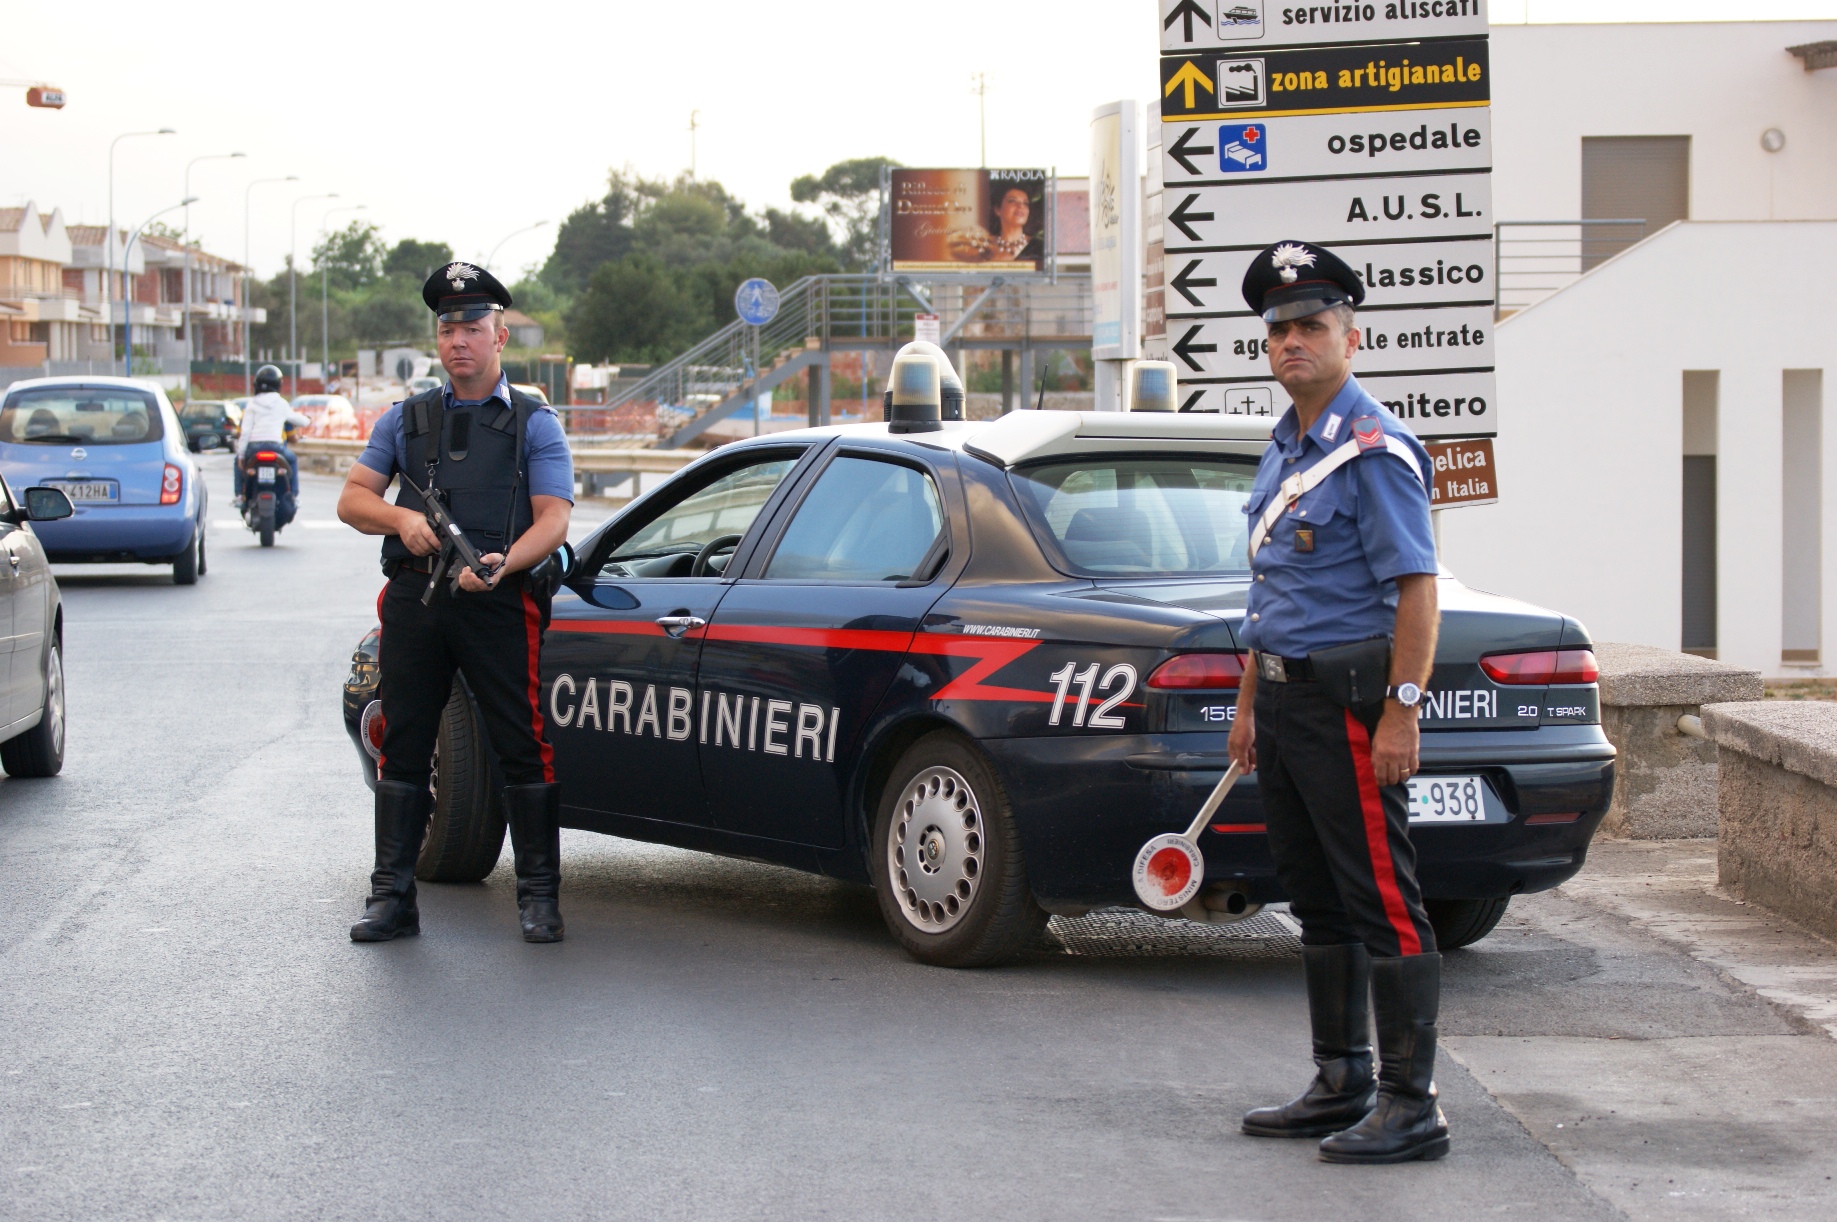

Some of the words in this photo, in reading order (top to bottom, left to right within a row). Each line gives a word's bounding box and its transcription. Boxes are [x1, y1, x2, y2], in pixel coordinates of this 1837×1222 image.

[1282, 0, 1375, 25] servizio
[1271, 70, 1329, 92] zona
[1338, 56, 1482, 92] artigianale
[1327, 123, 1482, 157] ospedale
[1001, 169, 1045, 182] RAJOLA
[1346, 192, 1482, 223] A.U.S.L.
[1397, 323, 1485, 348] entrate
[1447, 478, 1489, 498] Italia
[1048, 661, 1138, 729] 112
[550, 673, 841, 763] CARABINIERI
[1138, 845, 1157, 875] DIFESA
[1167, 838, 1200, 867] CARABINIERI
